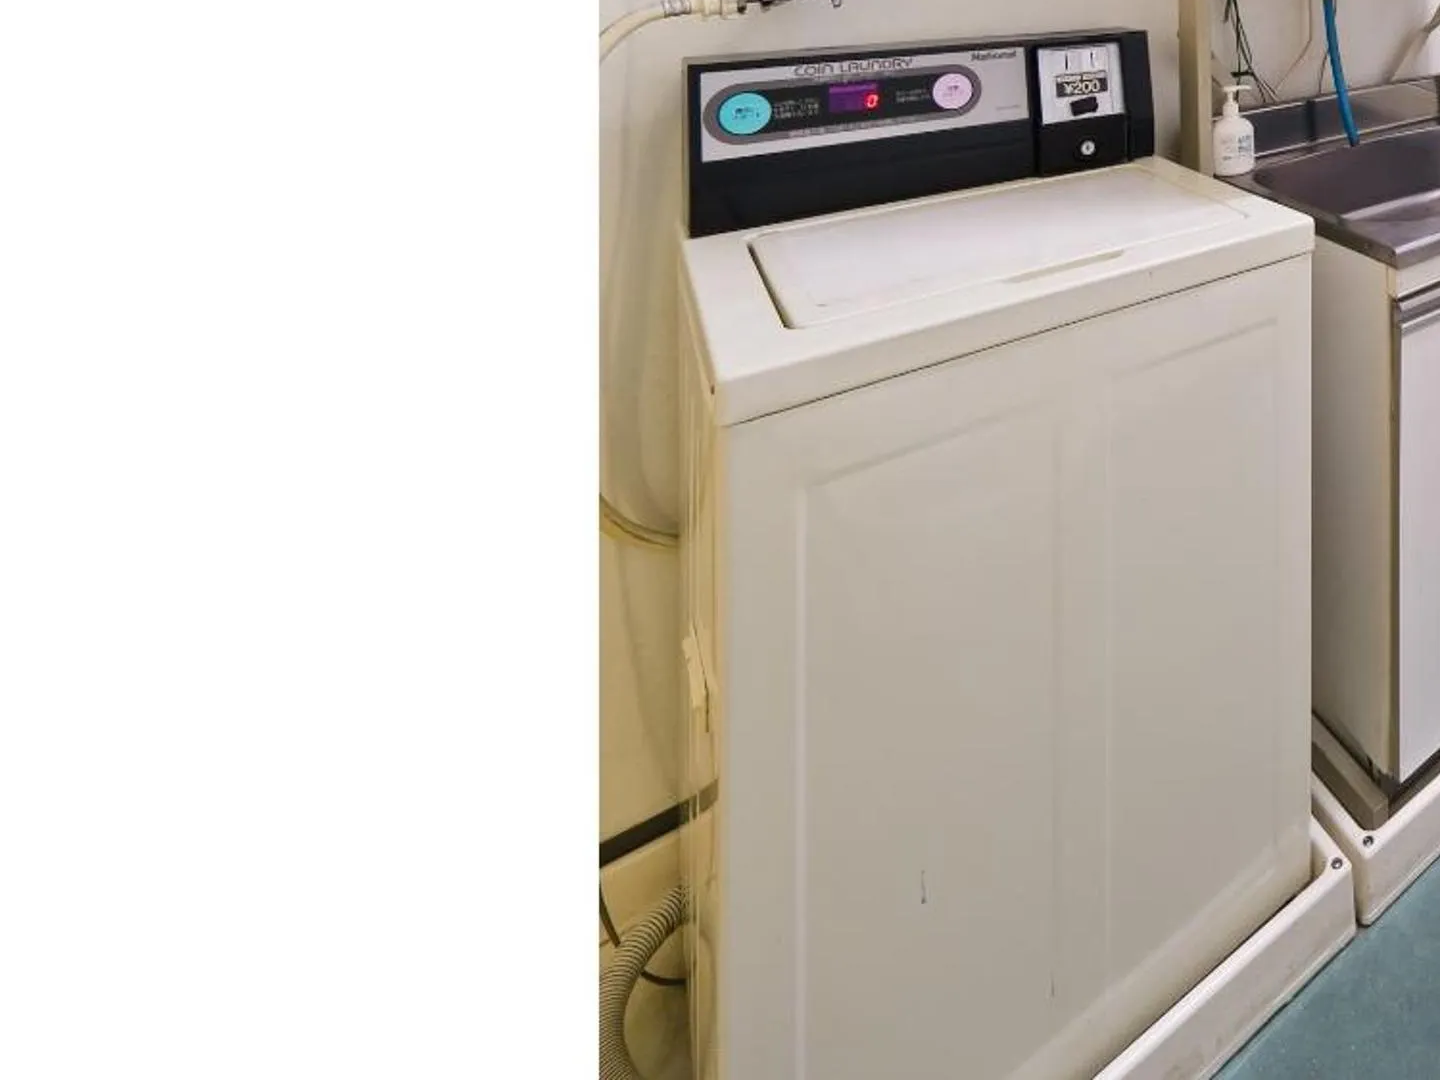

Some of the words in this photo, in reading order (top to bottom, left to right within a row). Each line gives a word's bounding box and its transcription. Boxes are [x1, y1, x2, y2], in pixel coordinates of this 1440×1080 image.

[971, 50, 1017, 61] National
[793, 63, 834, 77] COIN
[839, 57, 914, 73] LAUNDRY
[1063, 81, 1100, 95] ¥200
[865, 93, 880, 109] 0
